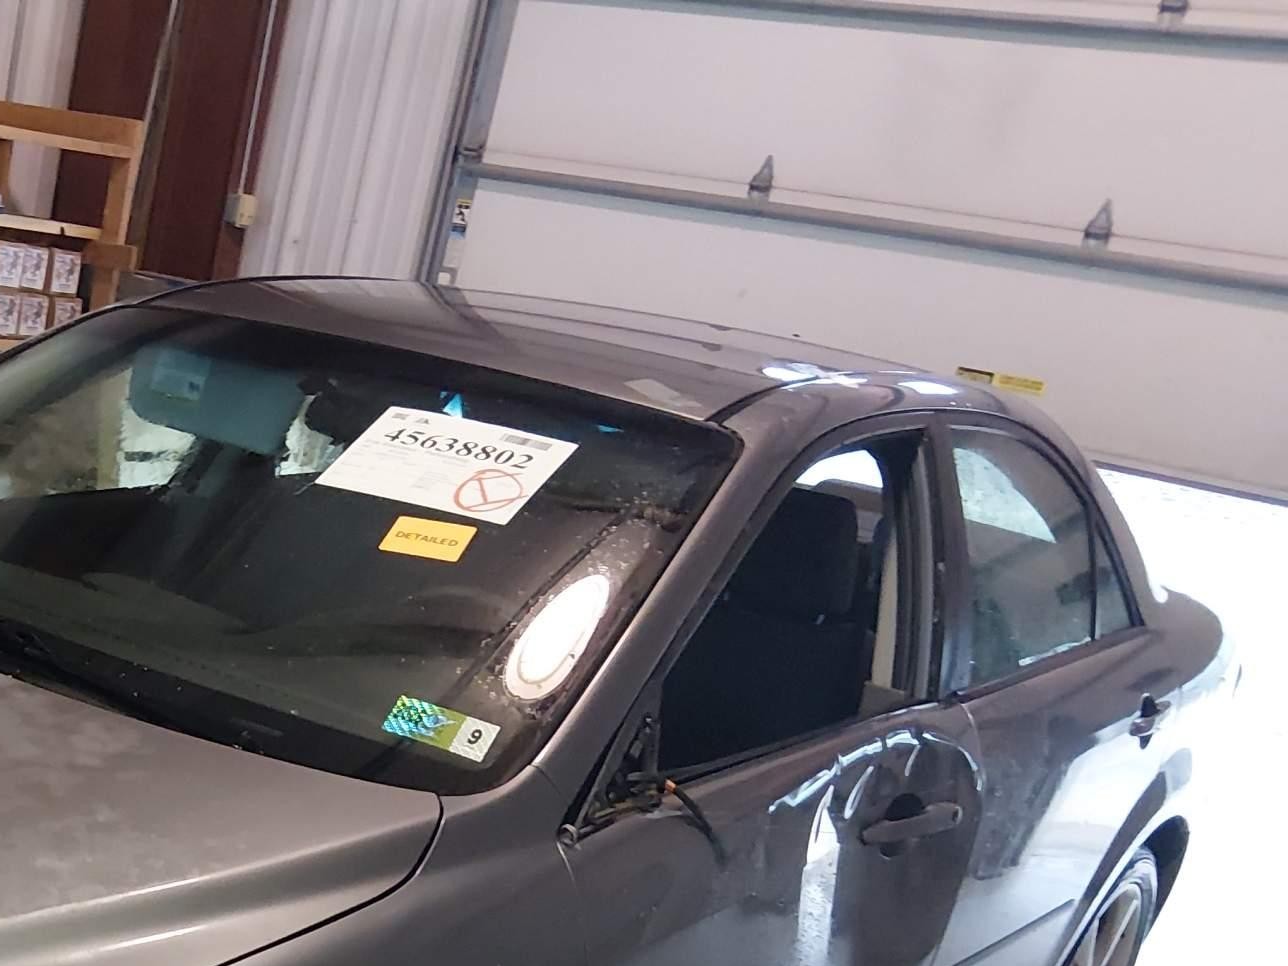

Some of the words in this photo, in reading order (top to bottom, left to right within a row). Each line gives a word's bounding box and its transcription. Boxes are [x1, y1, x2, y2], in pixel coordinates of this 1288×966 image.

[384, 428, 535, 470] 45638802
[395, 530, 459, 547] DETAILED
[467, 729, 483, 745] 9
